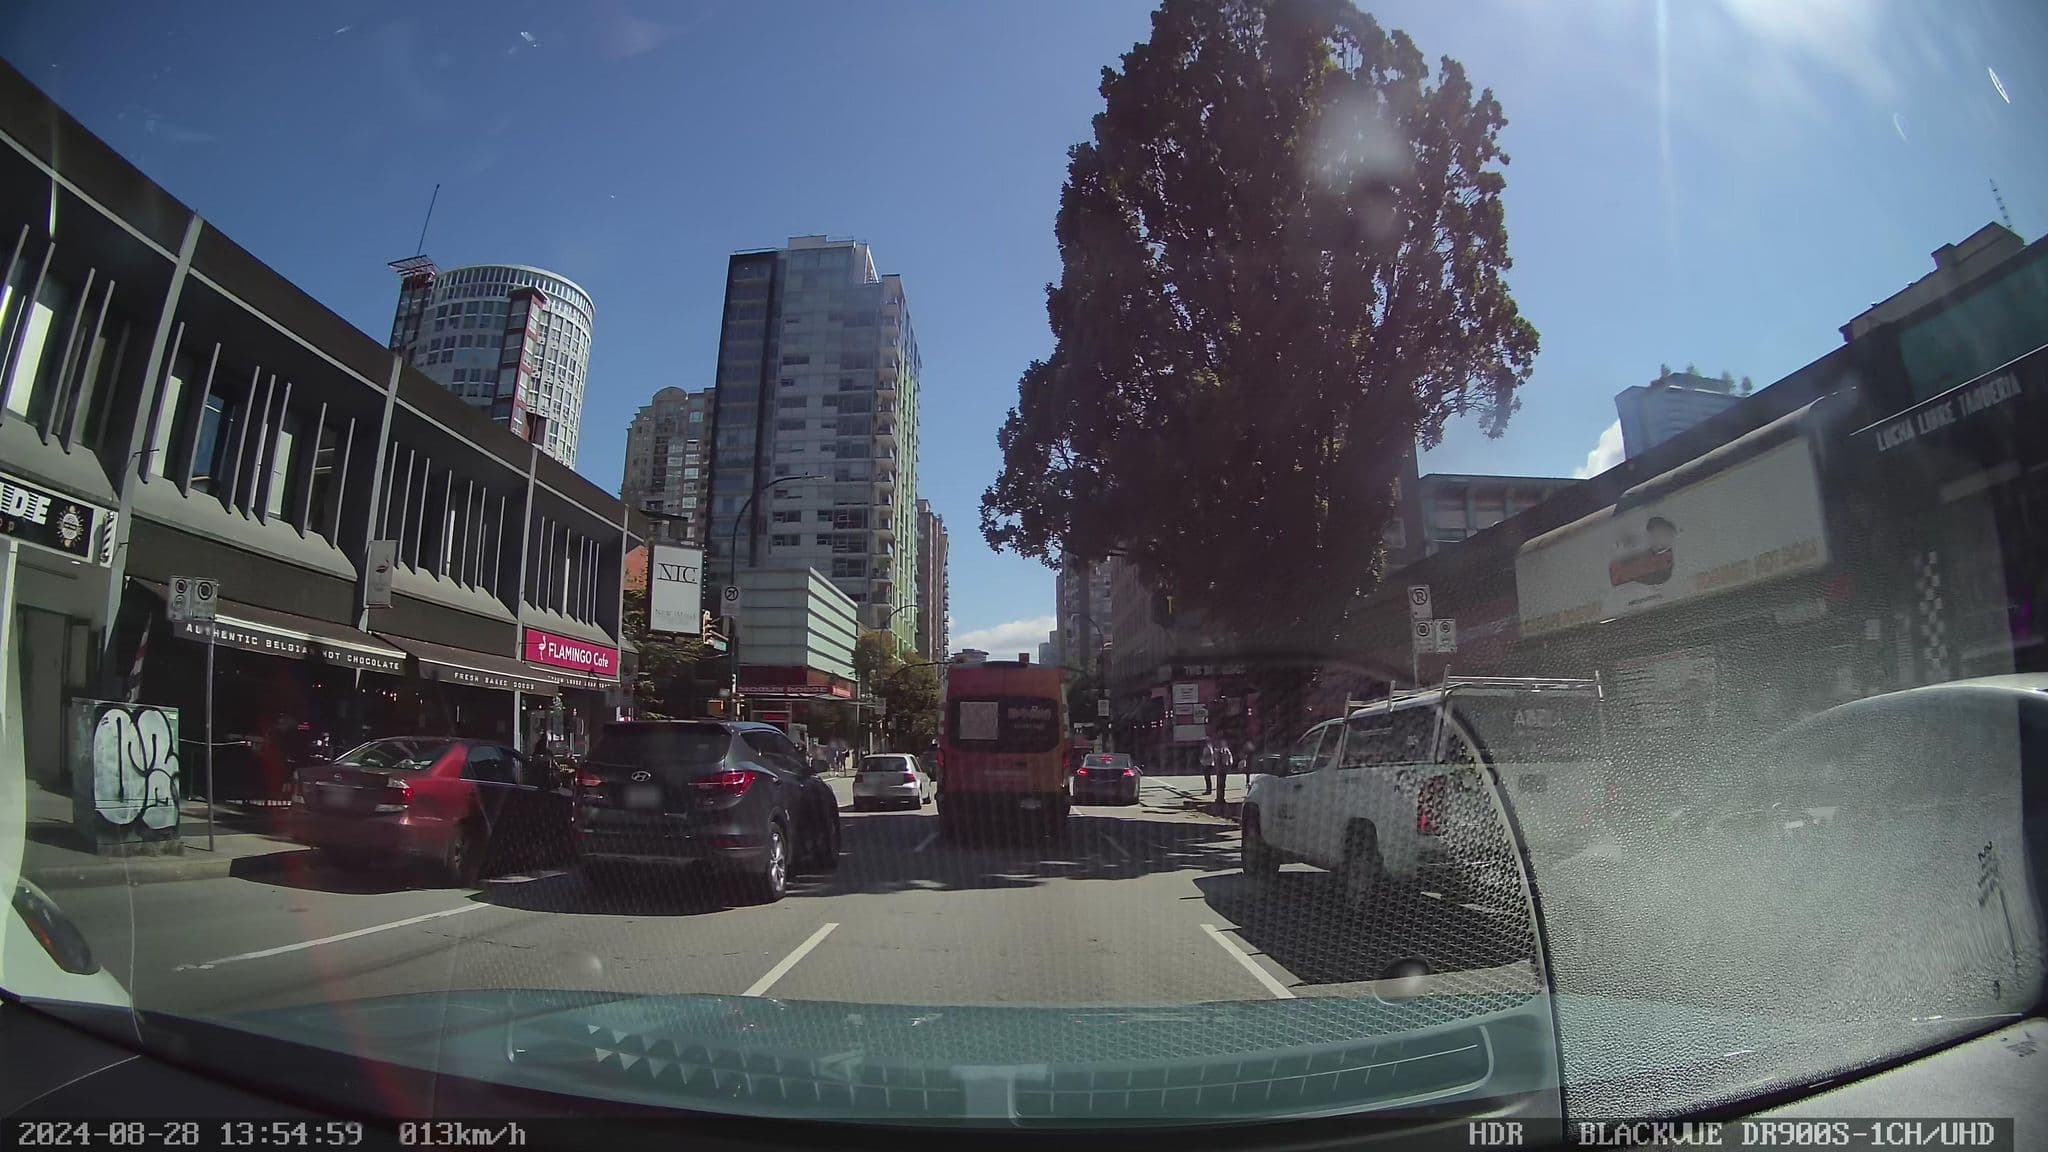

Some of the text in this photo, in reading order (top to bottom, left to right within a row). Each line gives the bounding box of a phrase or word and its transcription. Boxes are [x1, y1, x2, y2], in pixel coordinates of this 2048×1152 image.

[656, 562, 698, 584] NIC
[265, 639, 315, 655] BELGIA
[347, 654, 399, 670] CHOCOLATE
[548, 643, 609, 668] FLAMINGO Cafe
[454, 672, 479, 682] FRESH
